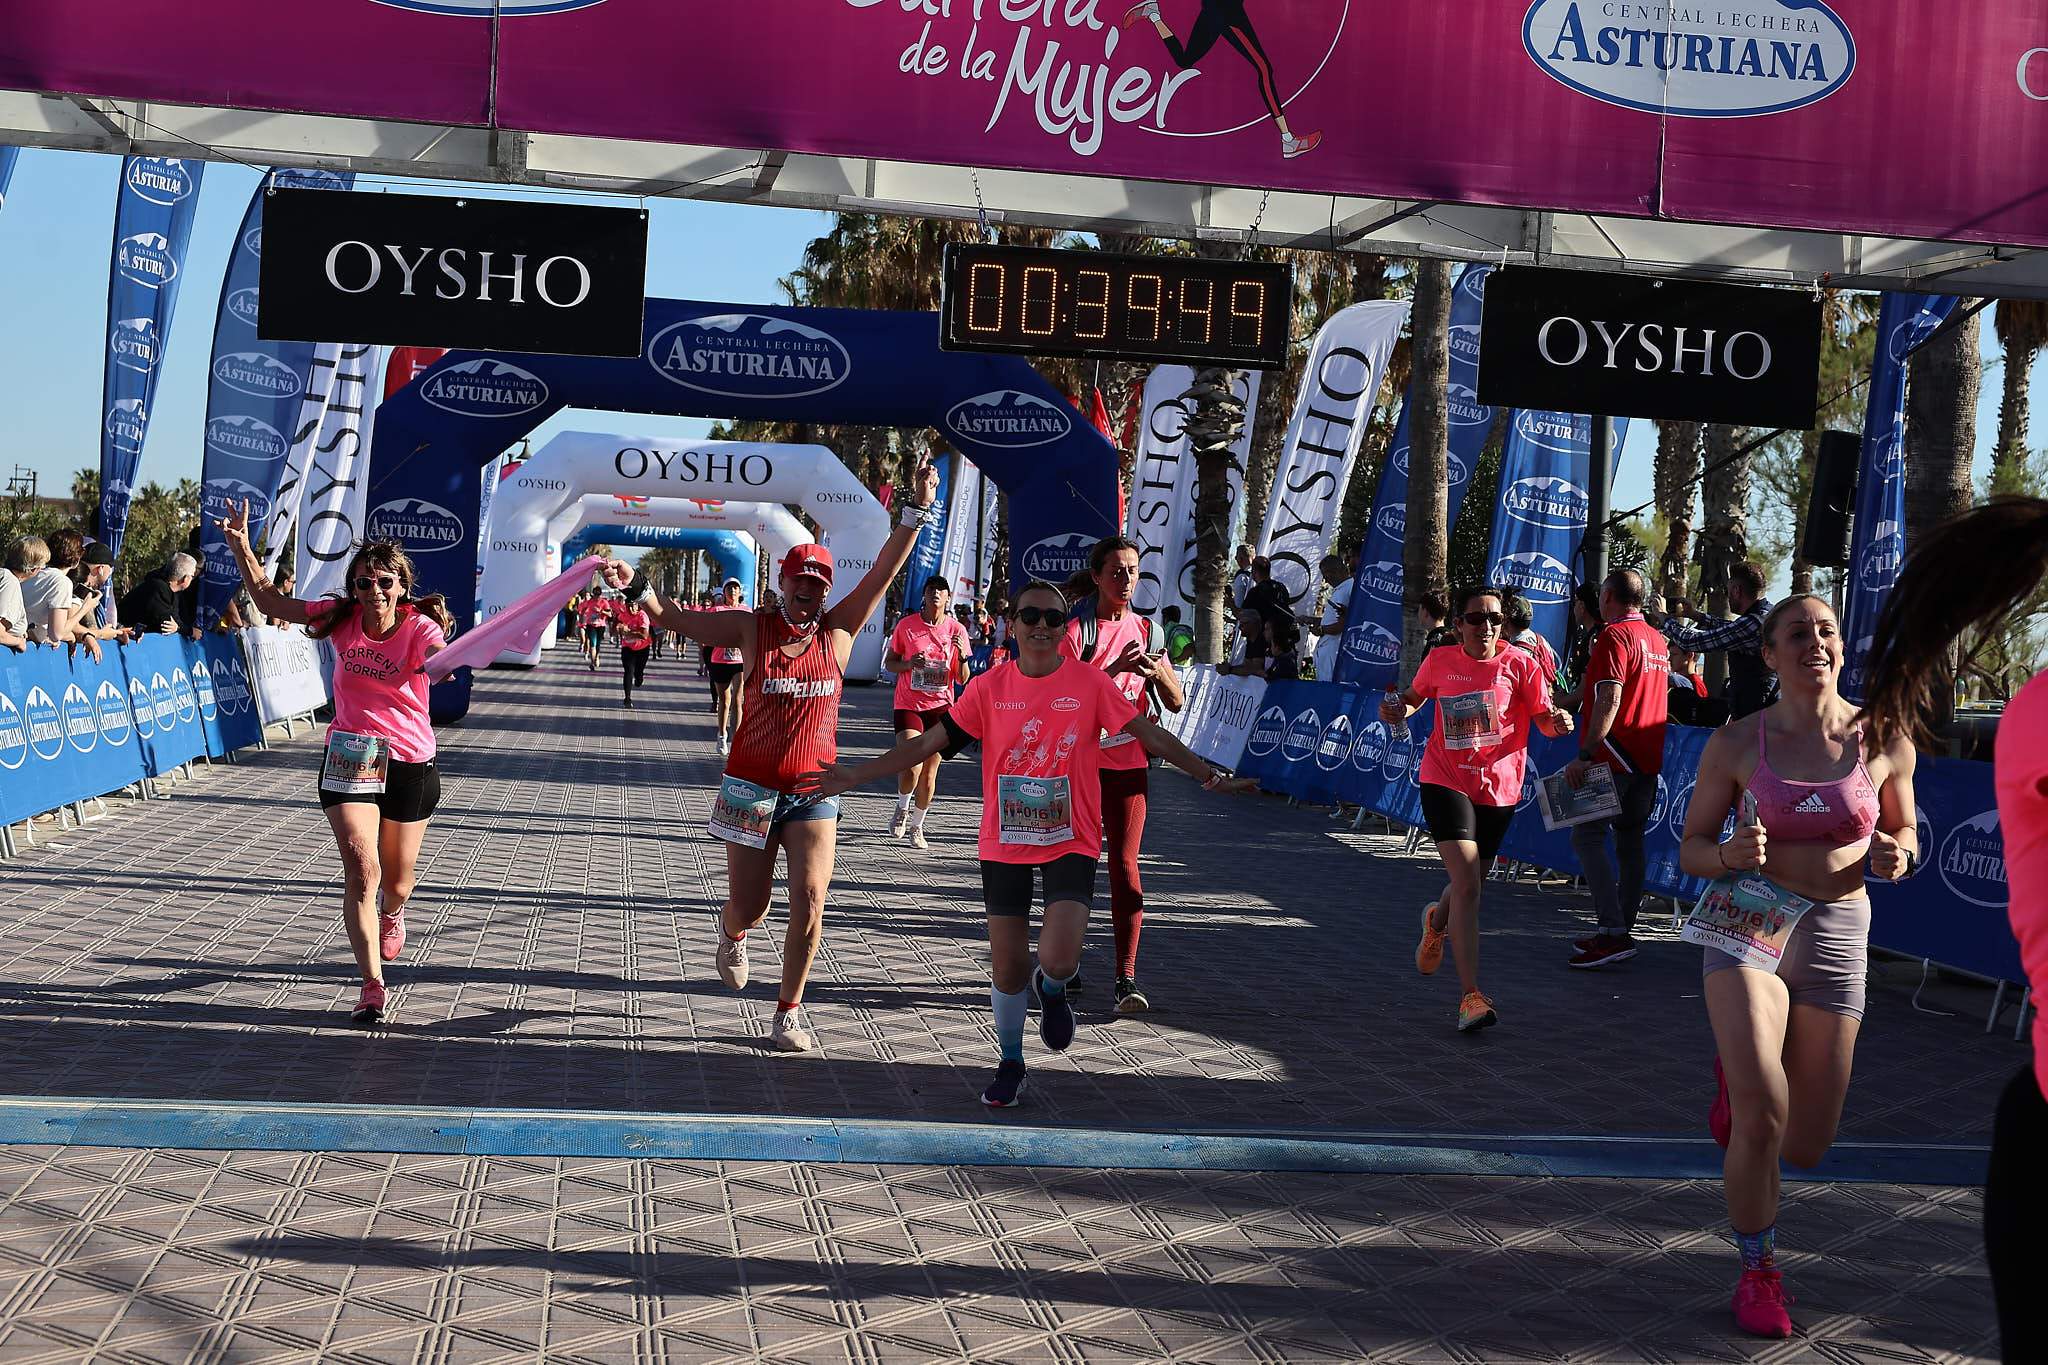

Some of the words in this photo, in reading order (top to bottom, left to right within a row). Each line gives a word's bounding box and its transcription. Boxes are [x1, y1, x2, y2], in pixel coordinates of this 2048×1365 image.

[1602, 2, 1705, 24] CENTRAL
[1716, 11, 1821, 34] LECHERA
[1547, 2, 1829, 82] ASTURIANA
[900, 21, 949, 75] de
[960, 22, 996, 81] la
[985, 26, 1201, 156] Mujer
[325, 240, 591, 308] OYSHO
[696, 335, 760, 348] CENTRAL
[766, 341, 830, 352] LECHERA
[1538, 316, 1772, 381] OYSHO
[663, 335, 836, 381] ASTURIANA
[219, 361, 294, 393] ASTURIANA
[428, 377, 538, 405] ASTURIANA
[956, 411, 1064, 432] ASTURIANA
[208, 424, 280, 455] ASTURIANA
[615, 447, 773, 486] OYSHO
[518, 478, 566, 491] OYSHO
[816, 491, 863, 505] OYSHO
[370, 516, 456, 541] ASTURIANA
[493, 540, 538, 553] OYSHO
[339, 647, 400, 675] TORRENT
[344, 661, 386, 681] CORRE
[762, 677, 834, 698] CORRELIANA
[994, 702, 1026, 710] OYSHO
[1795, 805, 1830, 813] adidas
[1692, 919, 1716, 931] CARRERA
[1693, 930, 1726, 945] OYSHO
